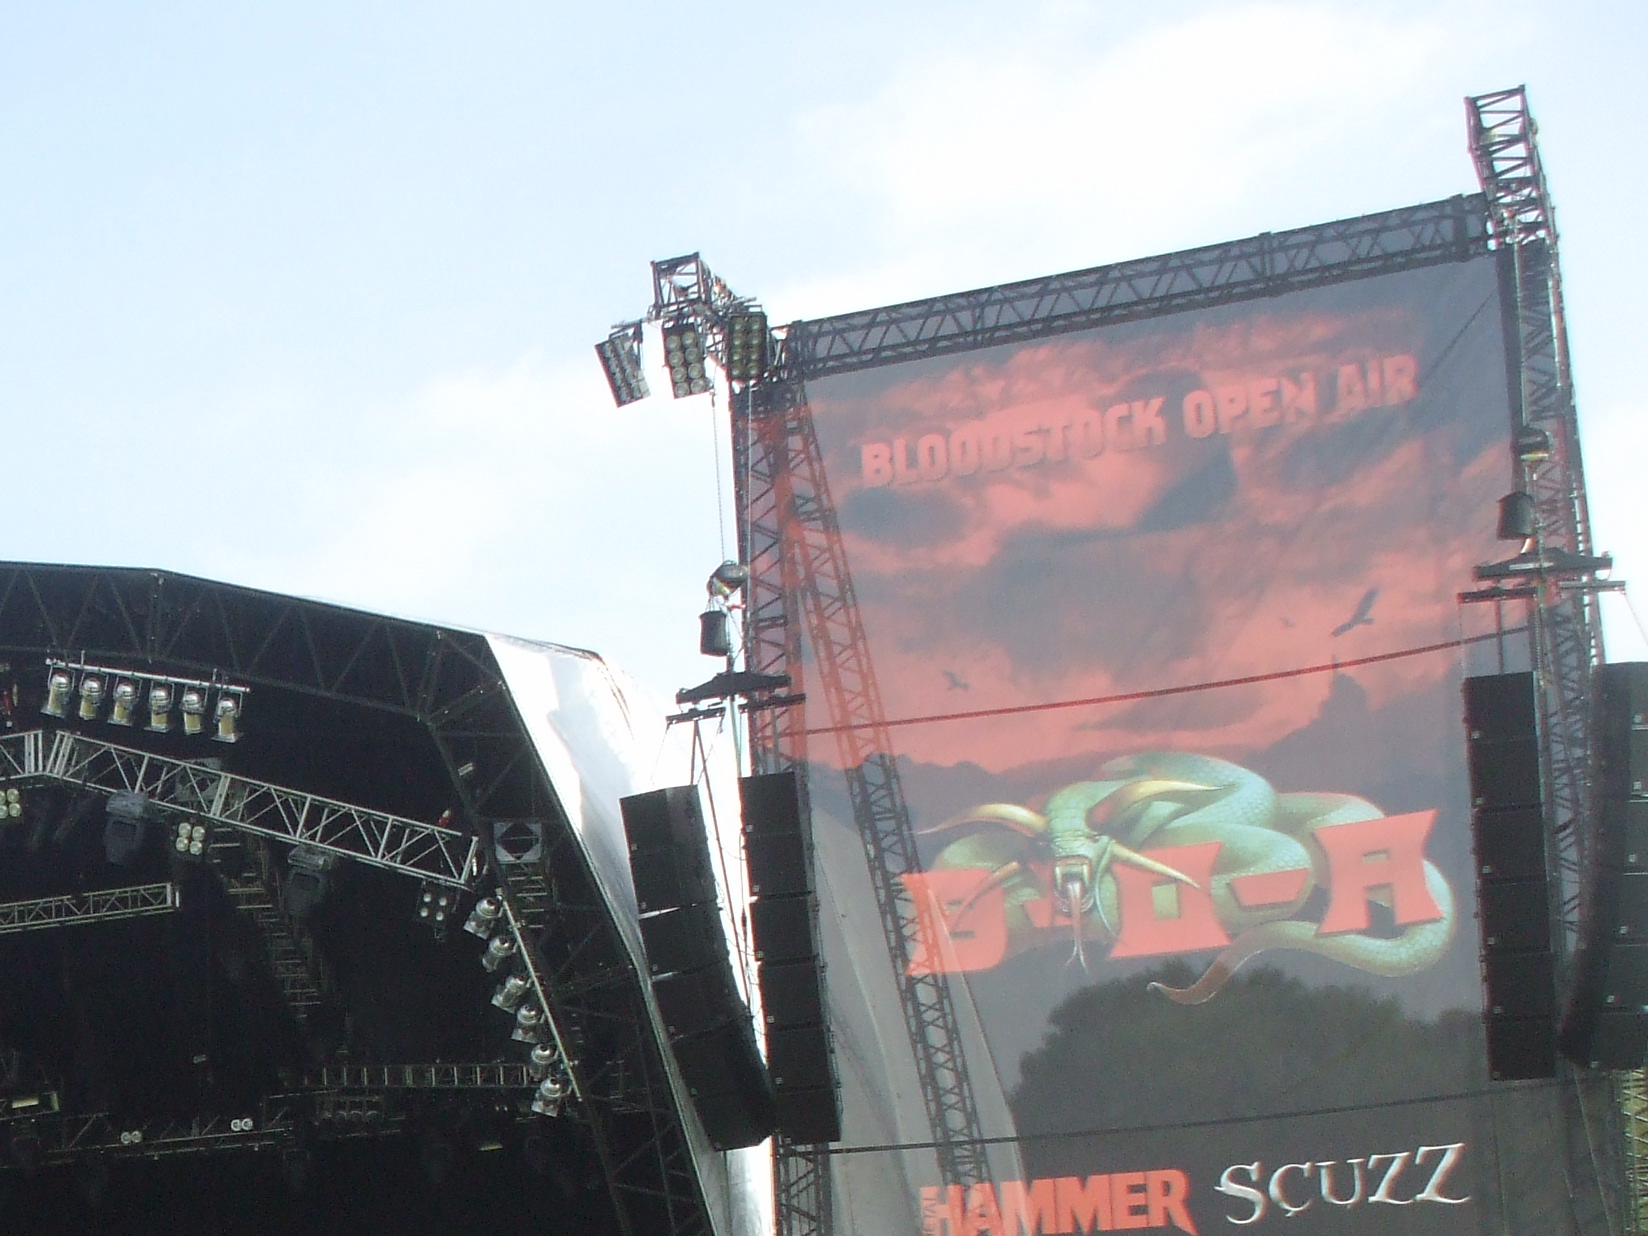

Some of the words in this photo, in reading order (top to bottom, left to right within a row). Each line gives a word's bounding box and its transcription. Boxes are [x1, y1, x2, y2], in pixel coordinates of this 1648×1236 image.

[860, 394, 1168, 488] BLOODSTOCK
[1182, 370, 1318, 440] OPEN
[1336, 354, 1420, 413] AIR
[1213, 1142, 1471, 1225] SCUZZ
